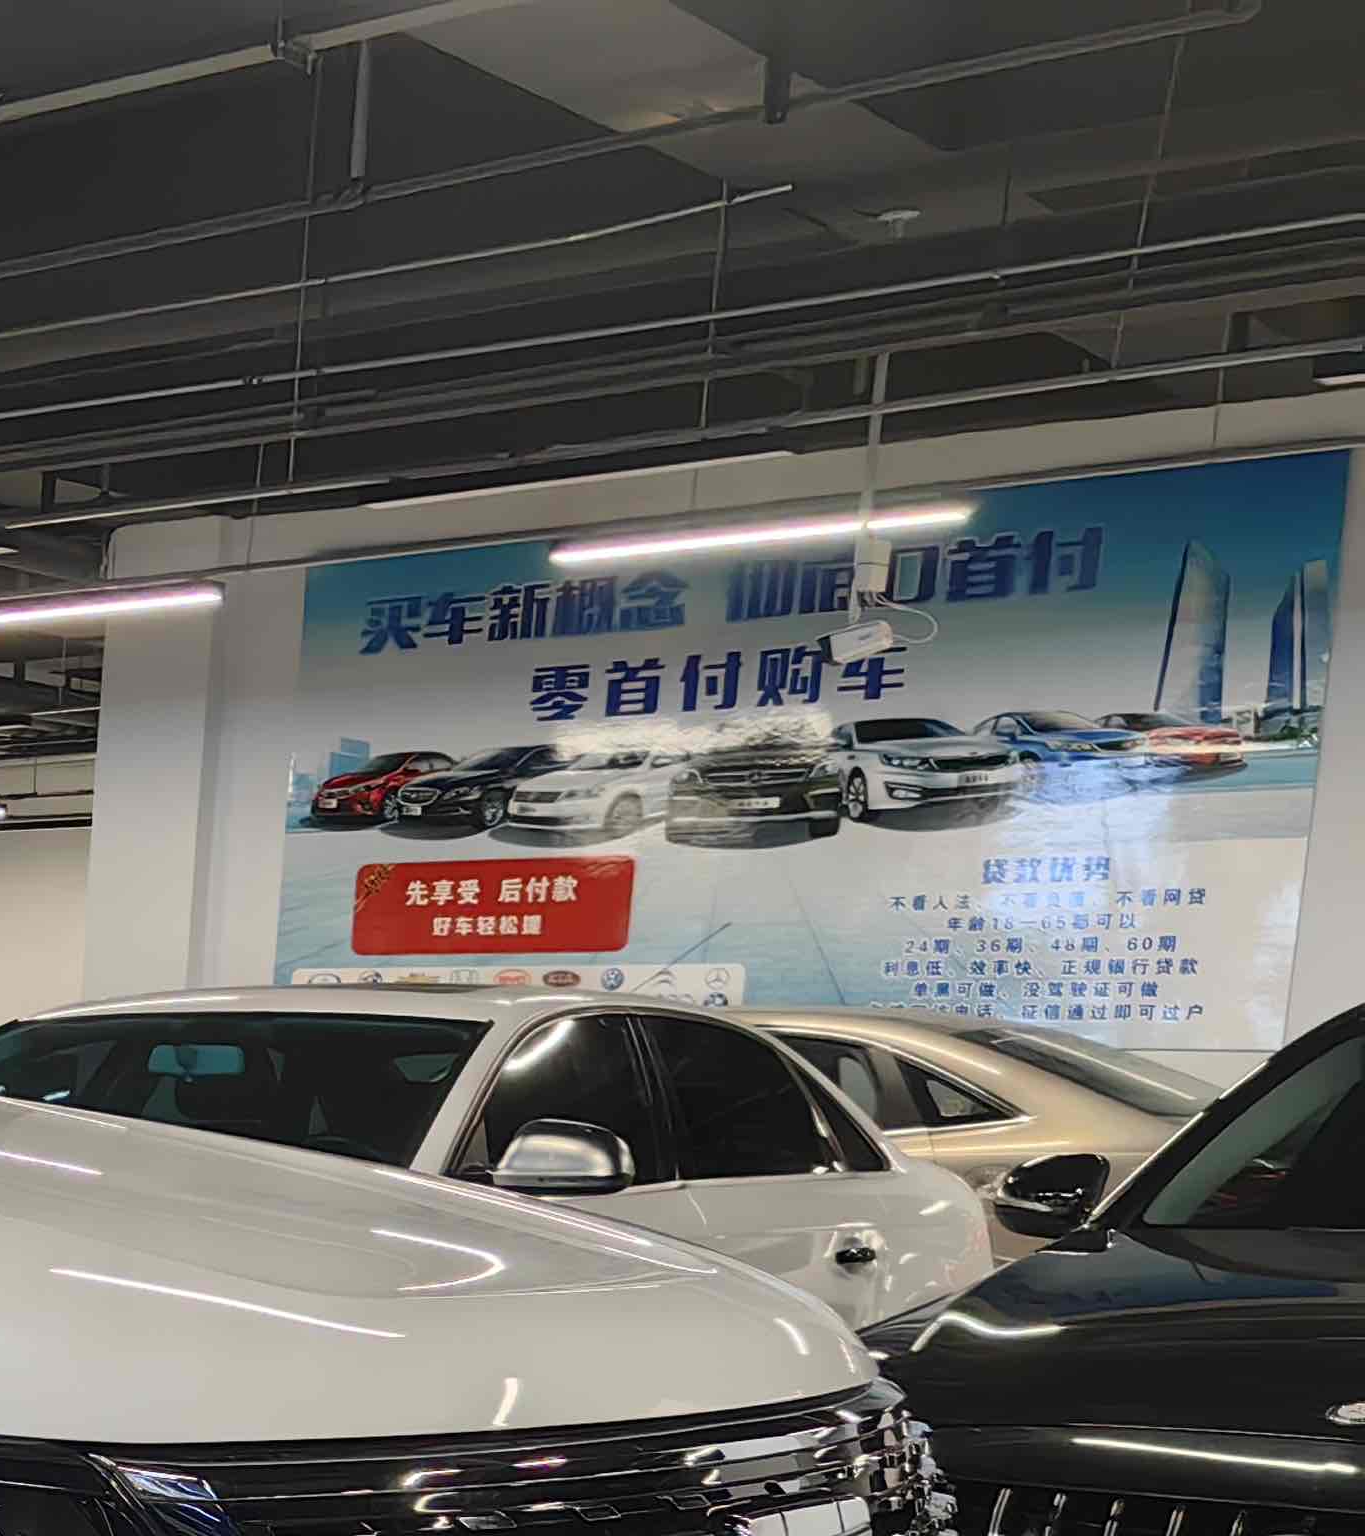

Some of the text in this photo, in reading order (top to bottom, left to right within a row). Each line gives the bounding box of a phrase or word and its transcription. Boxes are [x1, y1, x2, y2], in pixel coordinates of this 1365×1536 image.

[359, 570, 689, 655] 买车新概念
[529, 645, 909, 722] 零首付购车
[405, 875, 579, 907] 先享受 后付款
